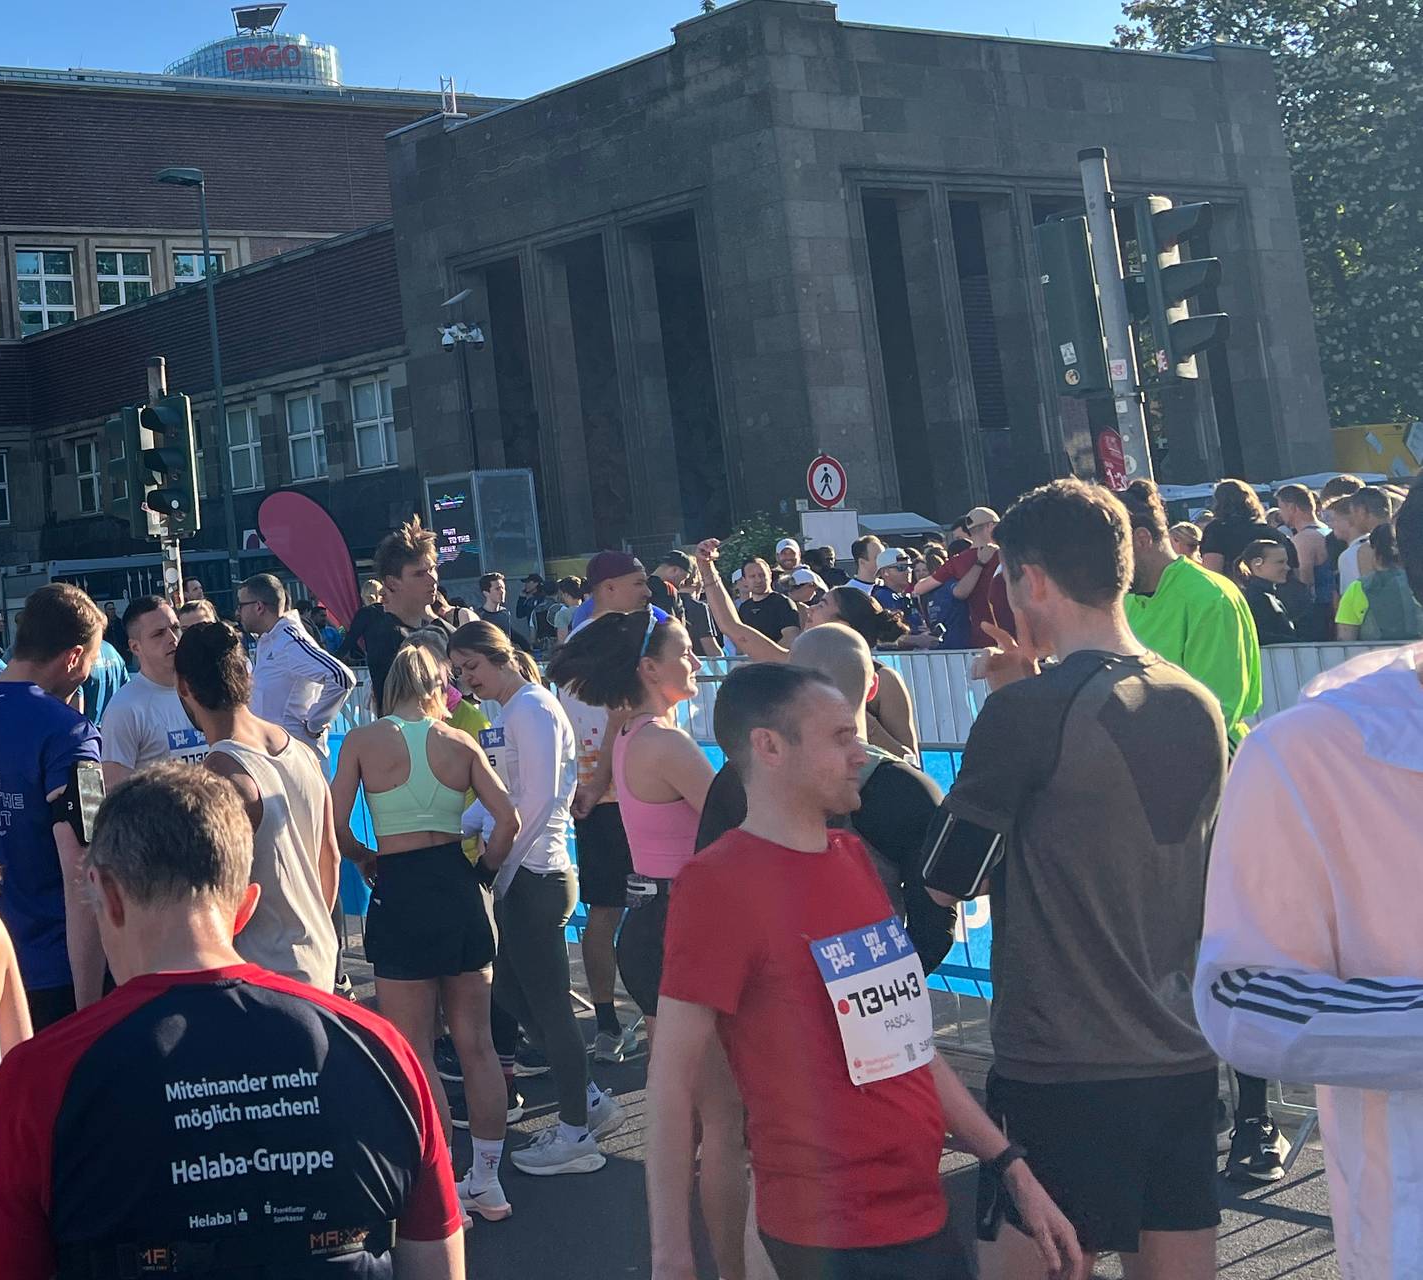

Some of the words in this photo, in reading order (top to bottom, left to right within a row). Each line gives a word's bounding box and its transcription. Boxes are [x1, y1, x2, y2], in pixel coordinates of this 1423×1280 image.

[227, 45, 301, 71] ERGO
[862, 927, 881, 948] uni
[886, 920, 900, 937] uni
[820, 938, 846, 960] uni
[869, 941, 888, 963] per
[893, 933, 909, 953] per
[830, 951, 857, 975] per
[884, 1014, 916, 1032] PASCAL
[165, 1073, 268, 1102] Miteinander
[272, 1068, 319, 1089] mehr
[174, 1102, 241, 1130] möglich
[244, 1096, 320, 1120] machen!
[171, 1148, 334, 1185] Helaba-Gruppe
[189, 1212, 232, 1229] Helaba
[273, 1206, 306, 1214] Frankfurter
[273, 1214, 304, 1223] Sparkasse
